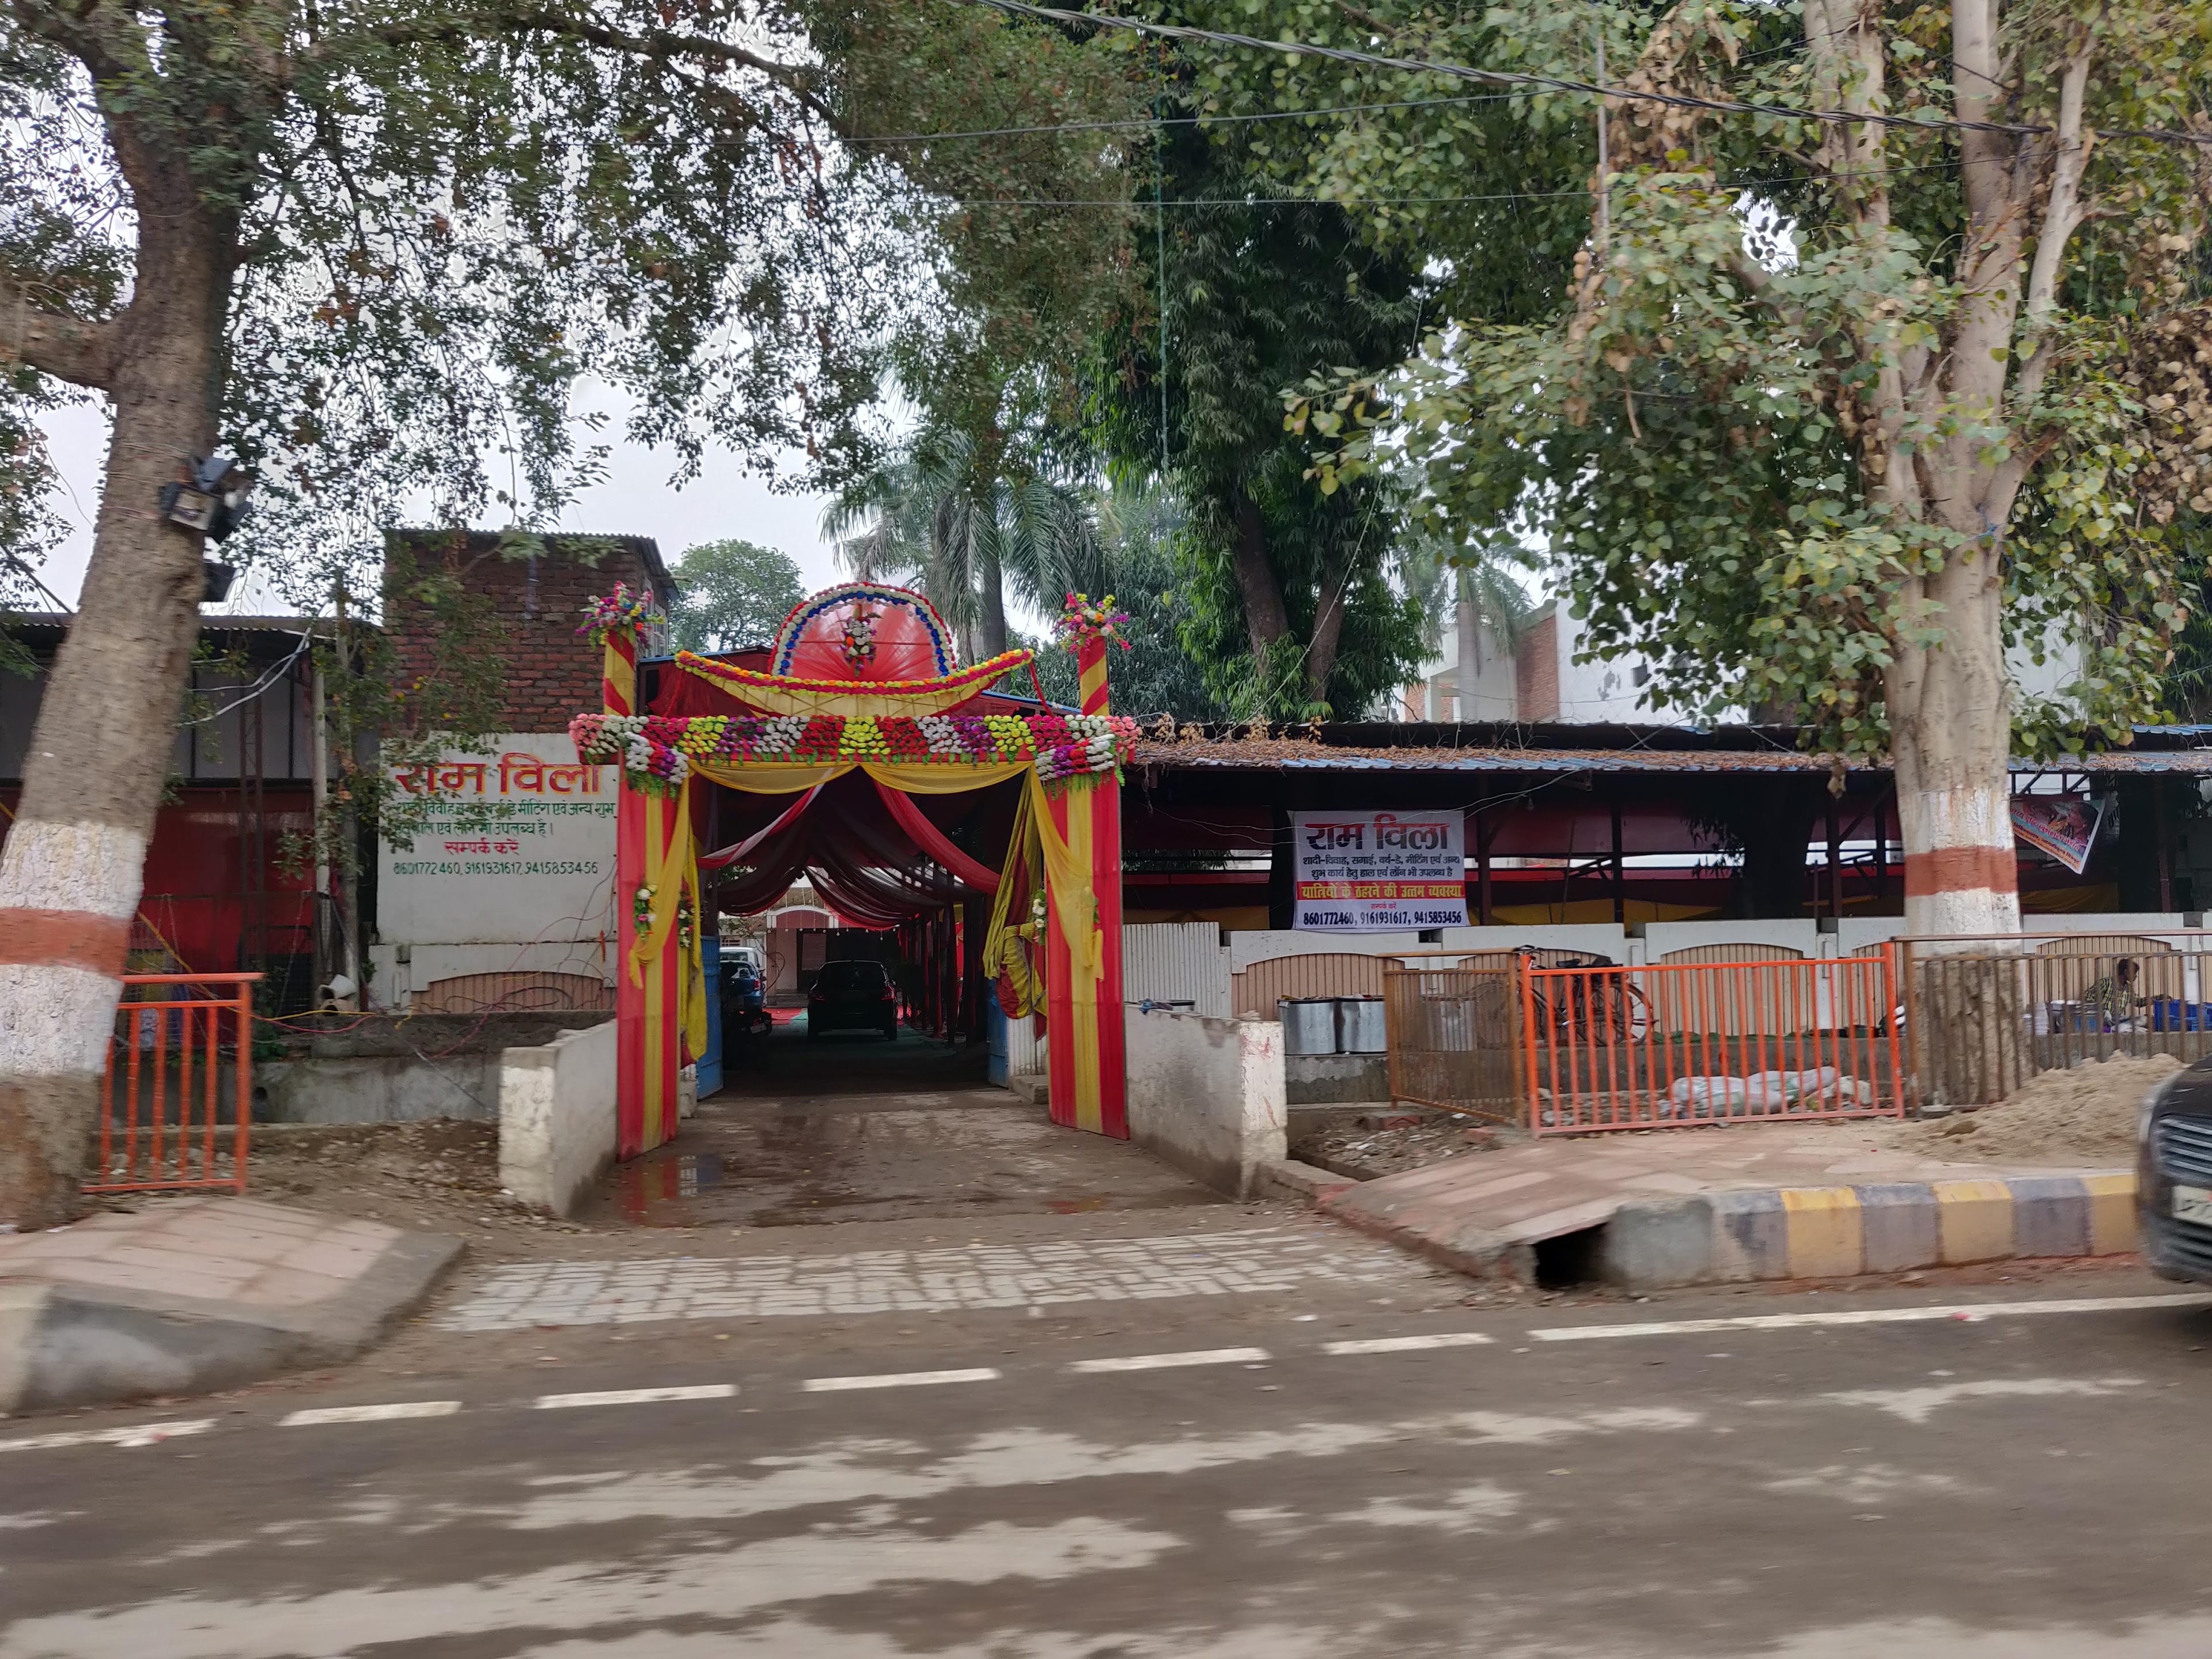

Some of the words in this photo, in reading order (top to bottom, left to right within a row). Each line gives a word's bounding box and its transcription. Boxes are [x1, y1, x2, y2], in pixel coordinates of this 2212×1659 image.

[395, 762, 487, 794] राम
[497, 752, 603, 794] विला
[552, 800, 567, 815] एवं
[569, 803, 593, 815] अन्य
[595, 803, 616, 818] शुभ
[537, 819, 547, 838] है
[1305, 823, 1365, 850] राम
[1373, 813, 1450, 850] विला
[444, 837, 491, 855] सम्पर्क
[1406, 854, 1428, 864] मीटिंग
[1430, 854, 1441, 864] एवं
[1443, 856, 1460, 864] अन्य
[525, 862, 598, 874] 9415853456
[1311, 869, 1326, 880] शुभ
[1327, 867, 1344, 876] कार्य
[1346, 867, 1358, 880] हेतु
[1377, 866, 1389, 877] एवं
[1389, 866, 1406, 877] लॉन
[1407, 866, 1417, 876] भी
[1446, 866, 1453, 877] है
[1301, 882, 1337, 898] यात्रियों
[1340, 883, 1351, 898] के
[1354, 882, 1380, 898] ठहरने
[1383, 882, 1397, 897] की
[1400, 885, 1425, 897] उत्तम
[1427, 885, 1462, 897] व्यवस्था
[1414, 911, 1461, 923] 9415853456
